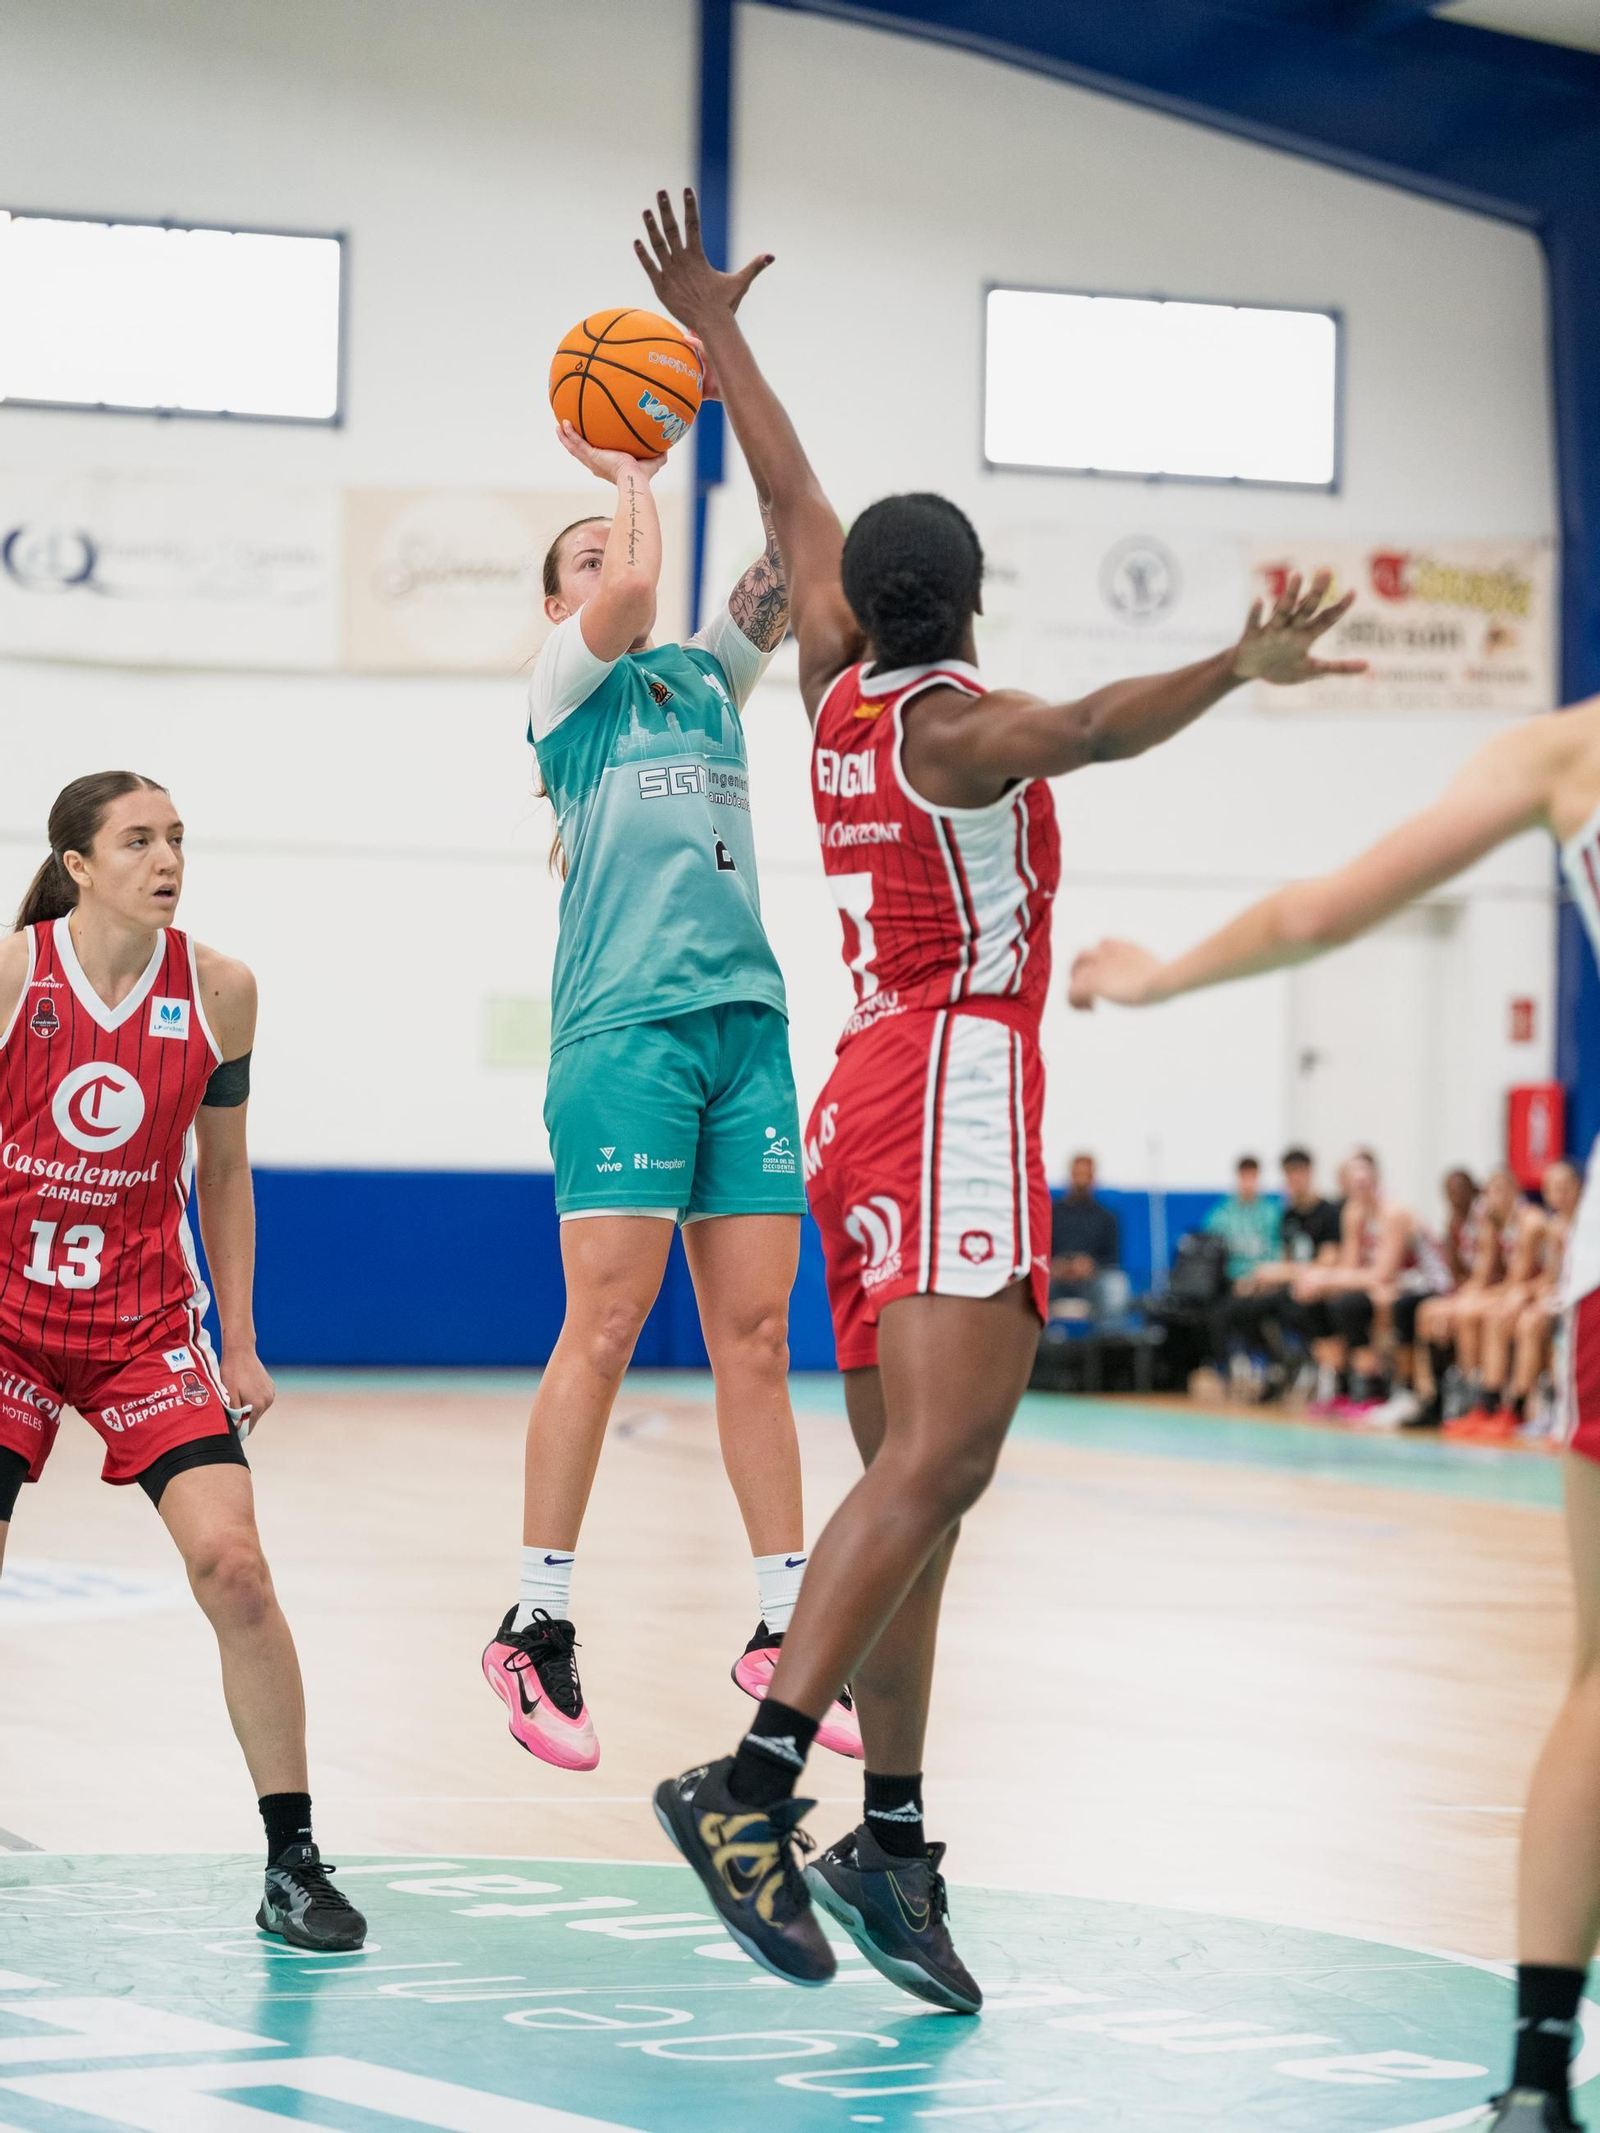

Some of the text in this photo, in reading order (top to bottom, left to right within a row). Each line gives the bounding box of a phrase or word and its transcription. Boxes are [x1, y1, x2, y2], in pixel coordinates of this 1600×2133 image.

[31, 981, 65, 989] MERCURY
[596, 1159, 686, 1173] vive Hospiten
[762, 1163, 796, 1171] OCCIDENTAL
[37, 1182, 118, 1207] ZARAGOZA
[23, 1219, 106, 1290] 13
[2, 1402, 44, 1431] HOTELES
[125, 1395, 184, 1428] DEPORTE
